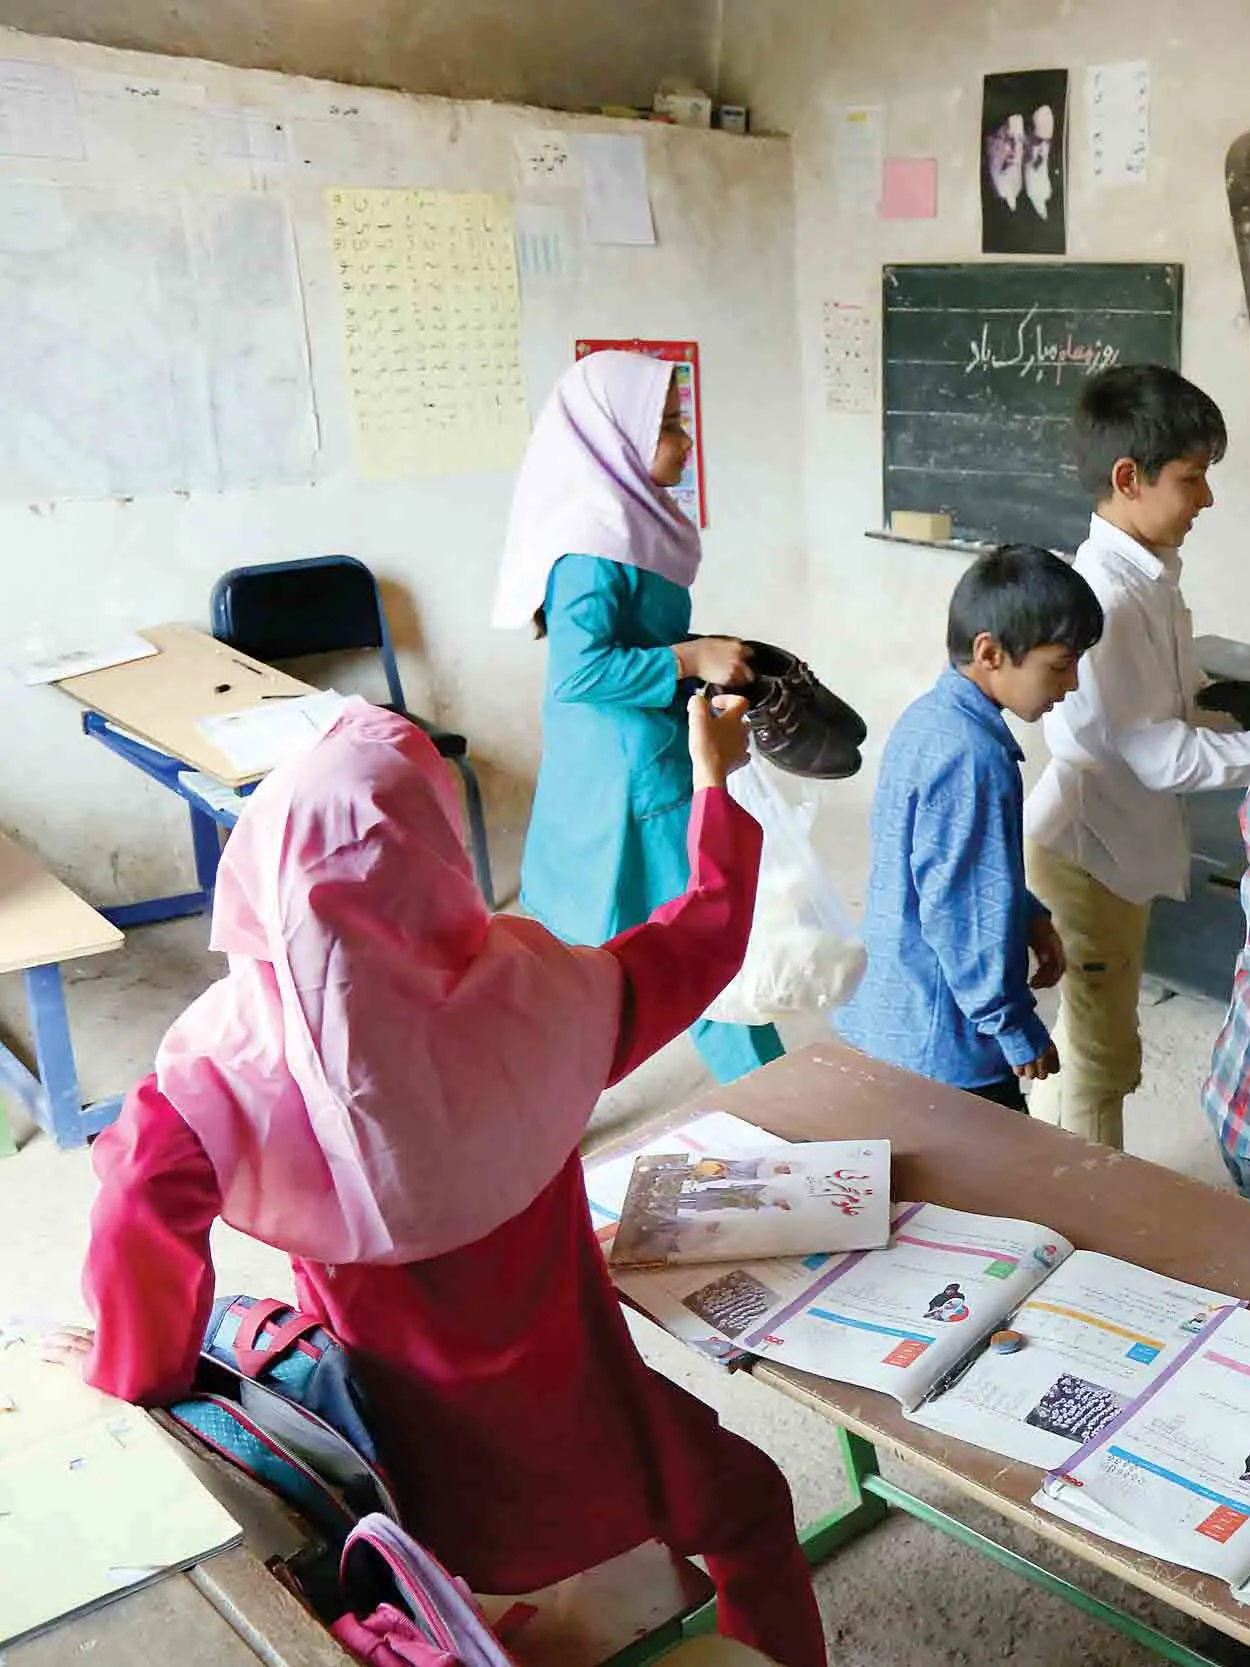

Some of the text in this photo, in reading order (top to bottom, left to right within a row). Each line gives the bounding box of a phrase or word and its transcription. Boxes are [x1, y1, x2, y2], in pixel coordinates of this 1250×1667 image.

[965, 322, 991, 376] باد
[992, 302, 1058, 383] مبارک
[1086, 340, 1120, 376] روز
